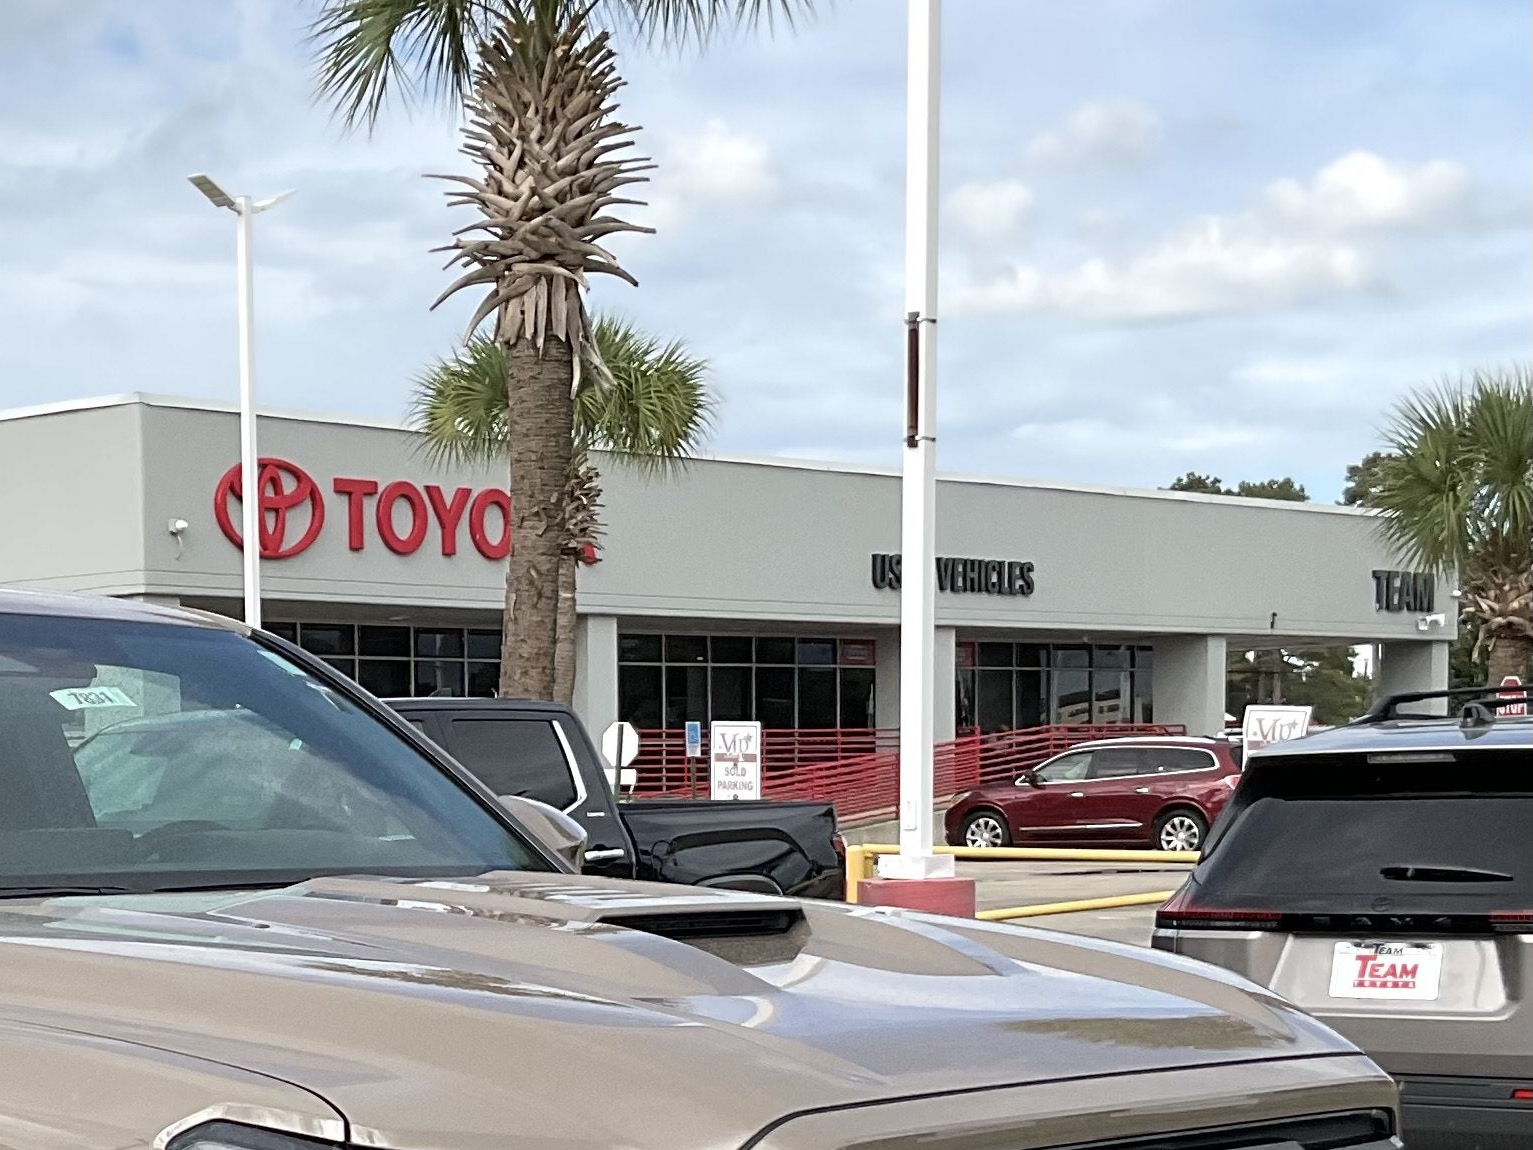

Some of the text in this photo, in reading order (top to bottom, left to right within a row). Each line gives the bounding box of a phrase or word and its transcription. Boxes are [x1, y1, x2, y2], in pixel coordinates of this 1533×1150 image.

[935, 557, 1035, 596] VEHICLES
[1372, 570, 1434, 612] TEAM
[725, 766, 747, 777] SOLD
[718, 781, 753, 791] PARKING
[1356, 955, 1419, 979] TEAM
